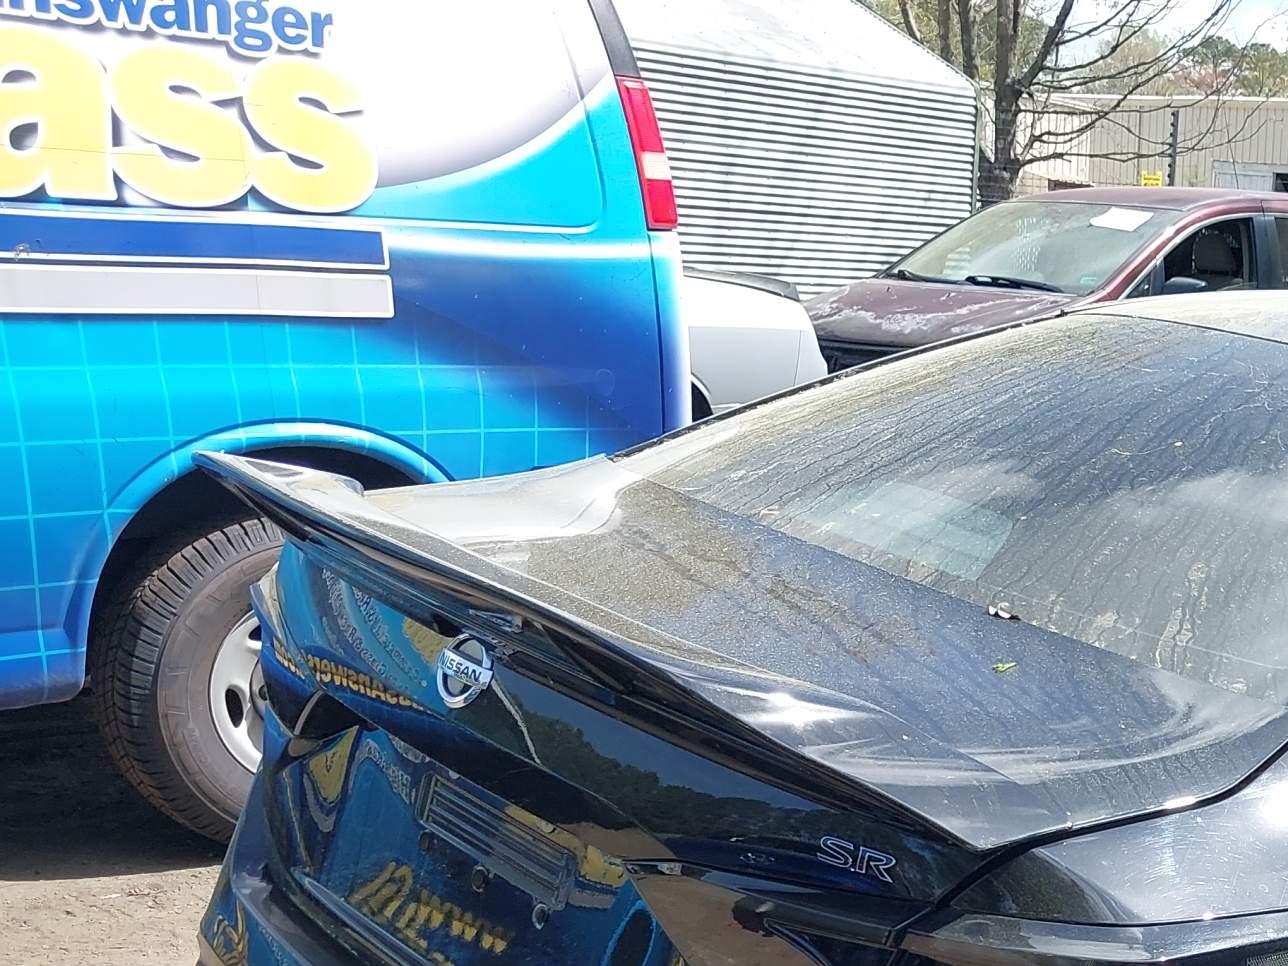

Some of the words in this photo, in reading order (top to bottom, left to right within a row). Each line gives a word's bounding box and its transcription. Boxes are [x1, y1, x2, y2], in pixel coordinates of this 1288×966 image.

[0, 0, 332, 51] swanger
[440, 650, 482, 683] NISSAN
[817, 836, 896, 883] SR
